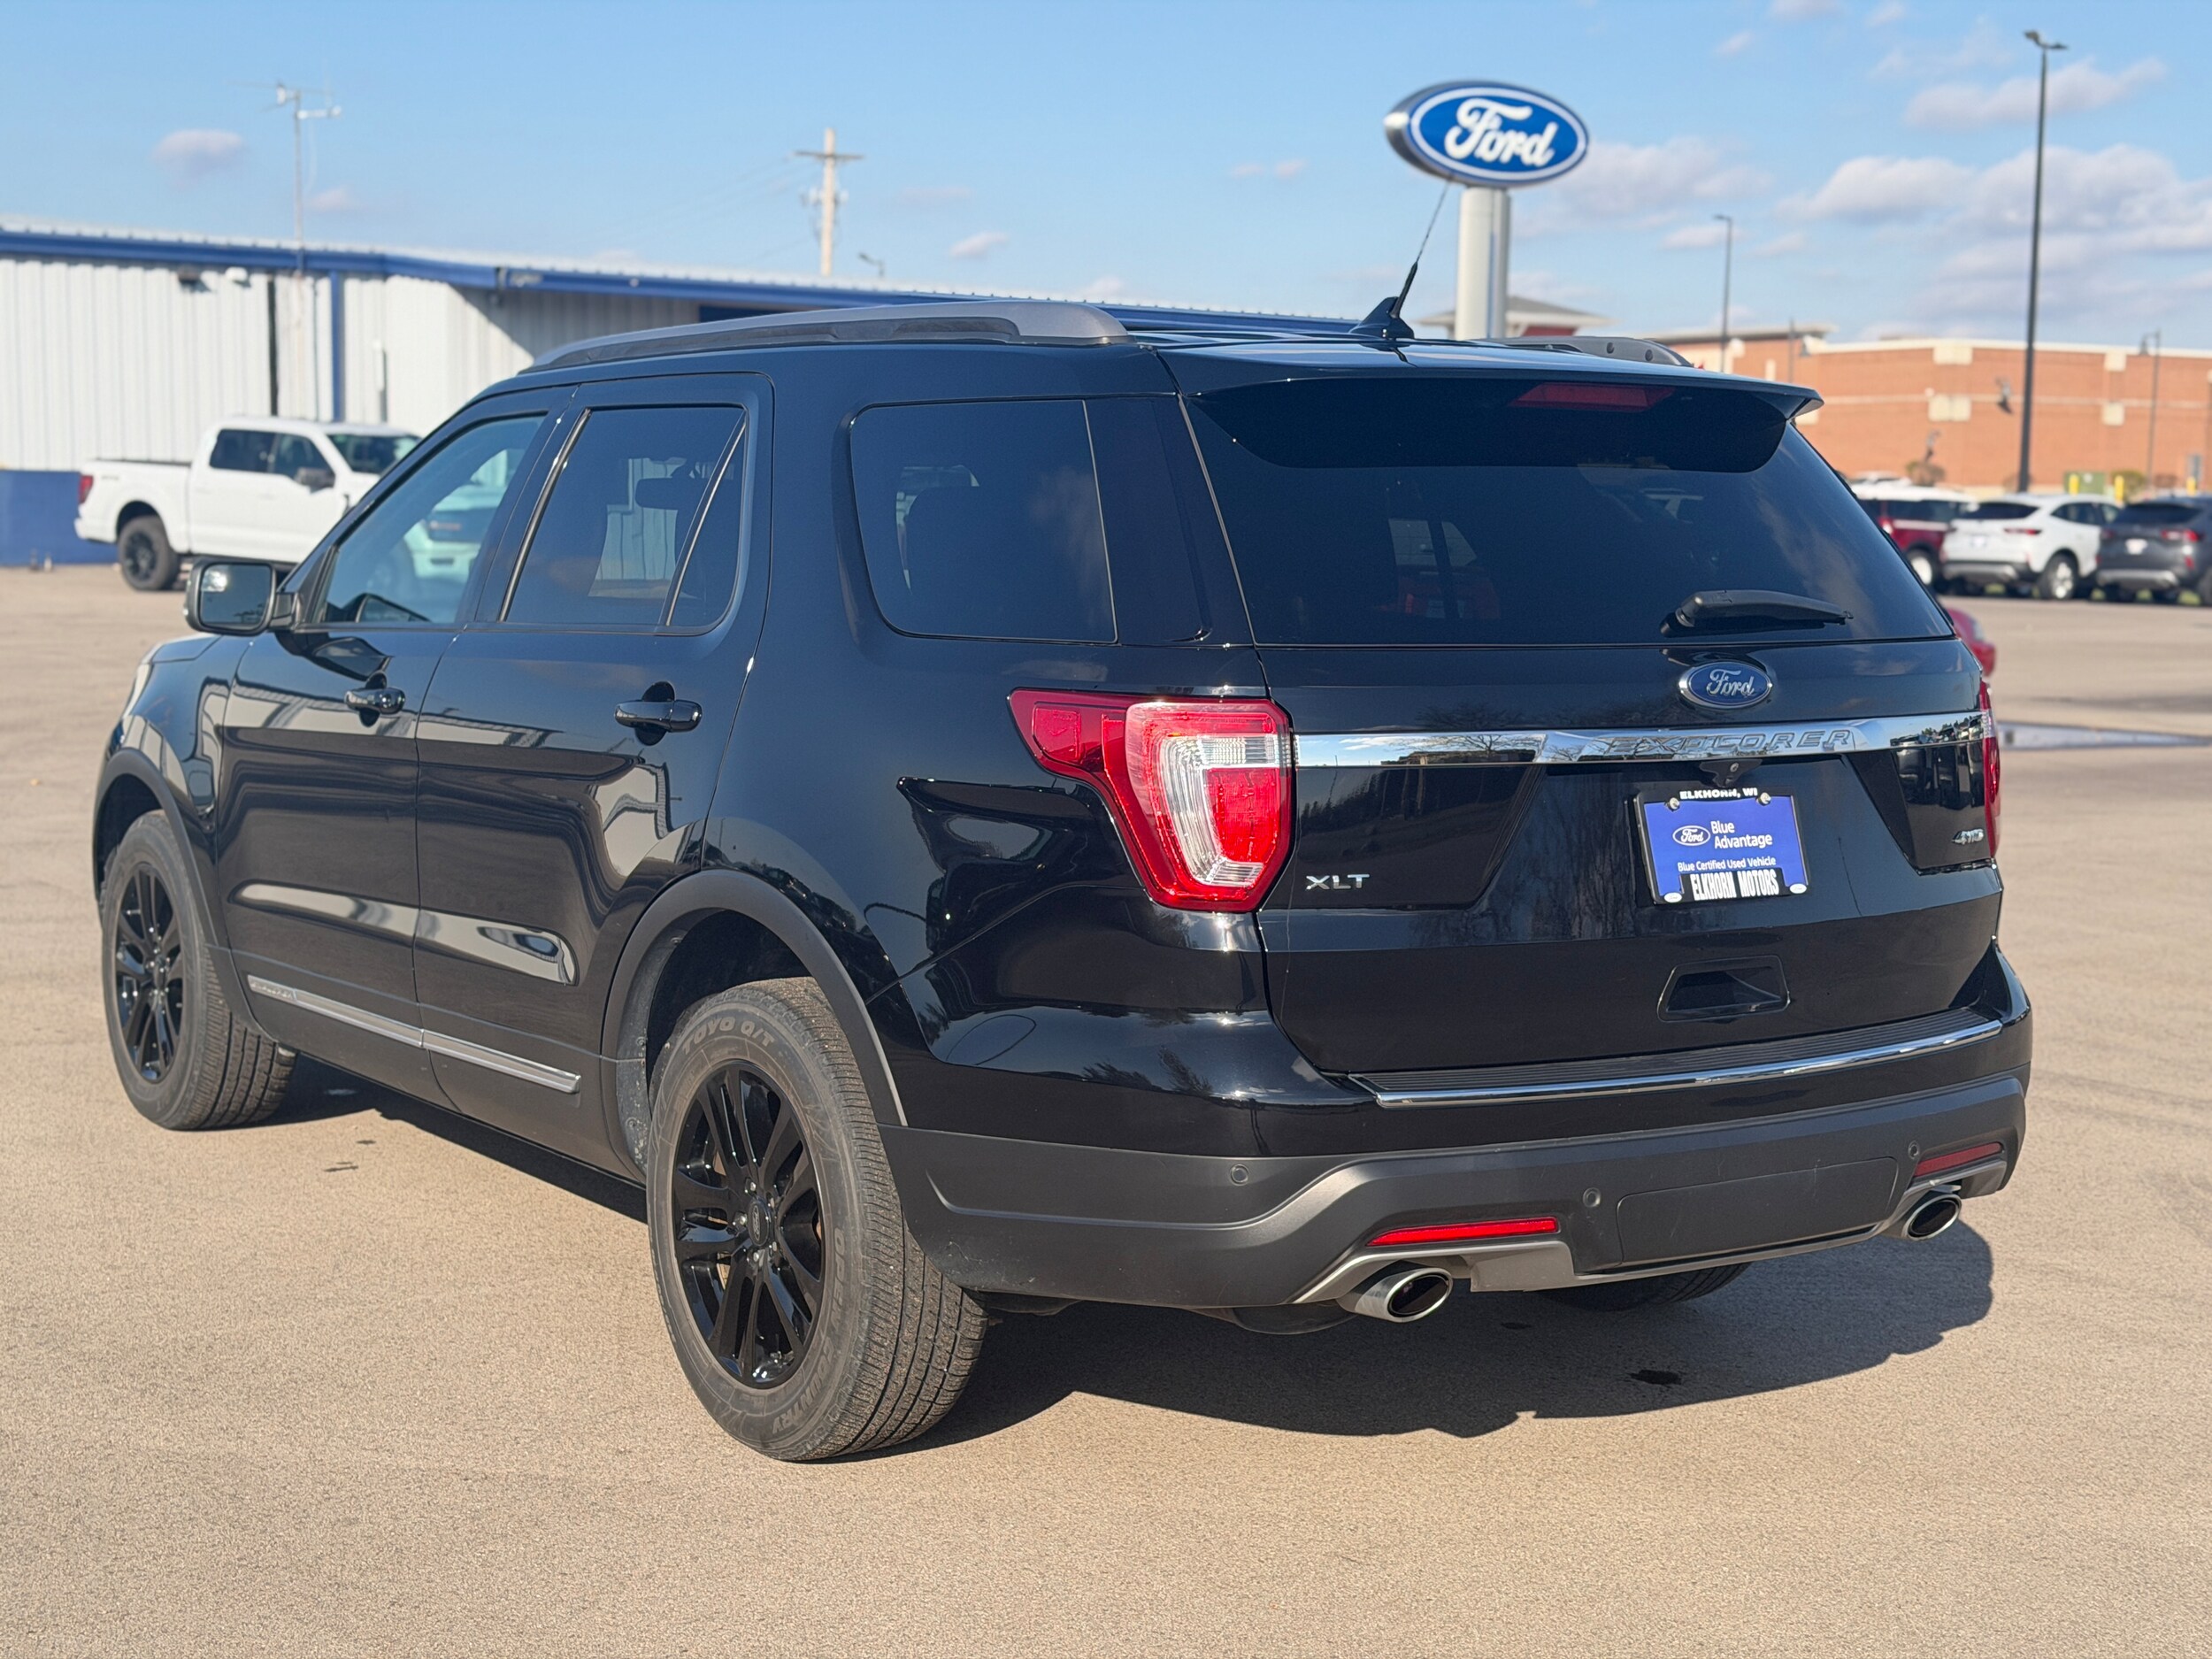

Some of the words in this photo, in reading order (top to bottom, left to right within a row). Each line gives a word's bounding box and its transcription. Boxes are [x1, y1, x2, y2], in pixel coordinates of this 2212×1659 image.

[1444, 97, 1560, 166] Ford
[1706, 669, 1755, 696] Ford
[1606, 729, 1851, 755] EXPLORER
[1679, 788, 1741, 800] ELKHORN,
[1742, 787, 1758, 797] WI
[1680, 828, 1704, 843] Ford
[1710, 820, 1735, 834] Blue
[1714, 833, 1773, 849] Advantage
[1677, 862, 1695, 872] Blue
[1696, 859, 1726, 871] Certified
[1727, 857, 1747, 869] Used
[1747, 856, 1777, 867] Vehicle
[1305, 873, 1371, 891] XLT
[1690, 872, 1737, 901] ELKHORN
[1737, 869, 1780, 898] MOTORS
[682, 1016, 736, 1056] TOYO
[830, 1227, 845, 1329] OPEN
[772, 1336, 835, 1435] COUNTRY
